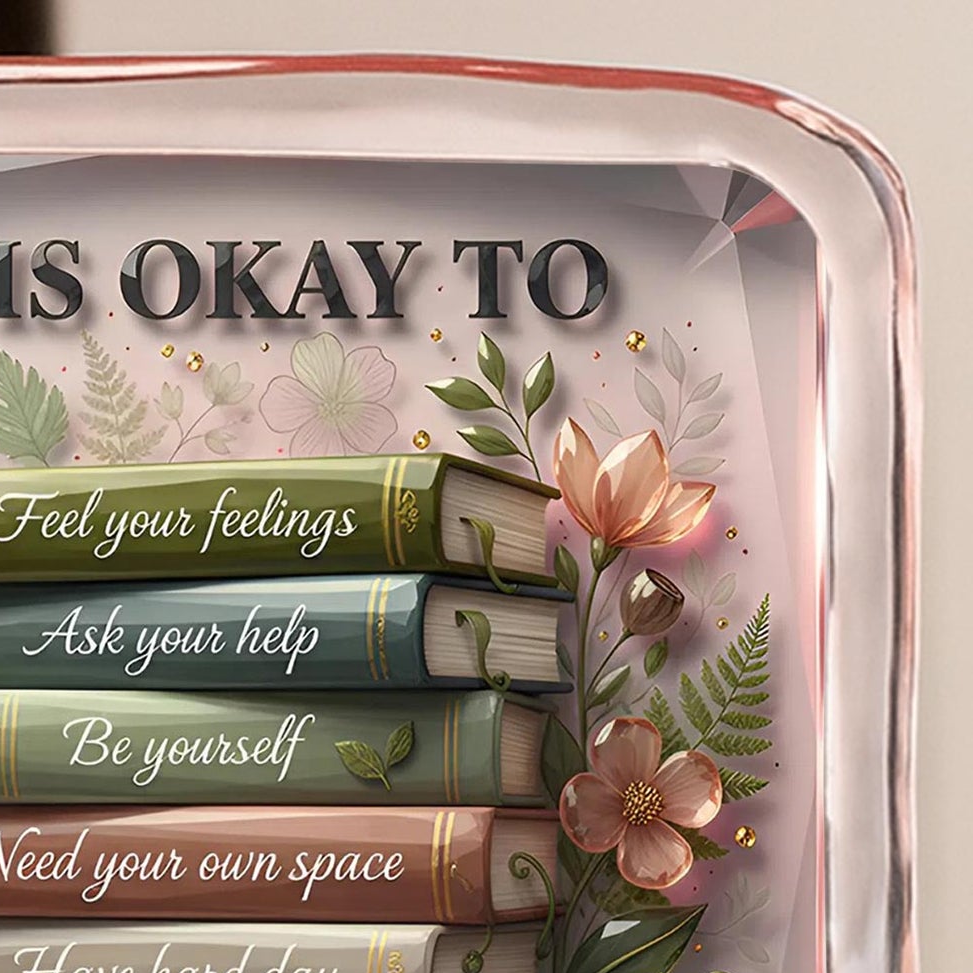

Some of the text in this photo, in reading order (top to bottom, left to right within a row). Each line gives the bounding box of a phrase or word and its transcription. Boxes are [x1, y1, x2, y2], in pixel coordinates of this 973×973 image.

[119, 239, 424, 320] OKAY
[453, 239, 610, 320] TO
[95, 507, 196, 557] your
[199, 488, 357, 556] feelings
[23, 605, 319, 675] Ask your help
[63, 715, 315, 786] Be yourself
[82, 849, 186, 902] your
[198, 855, 282, 881] own
[290, 849, 404, 901] space
